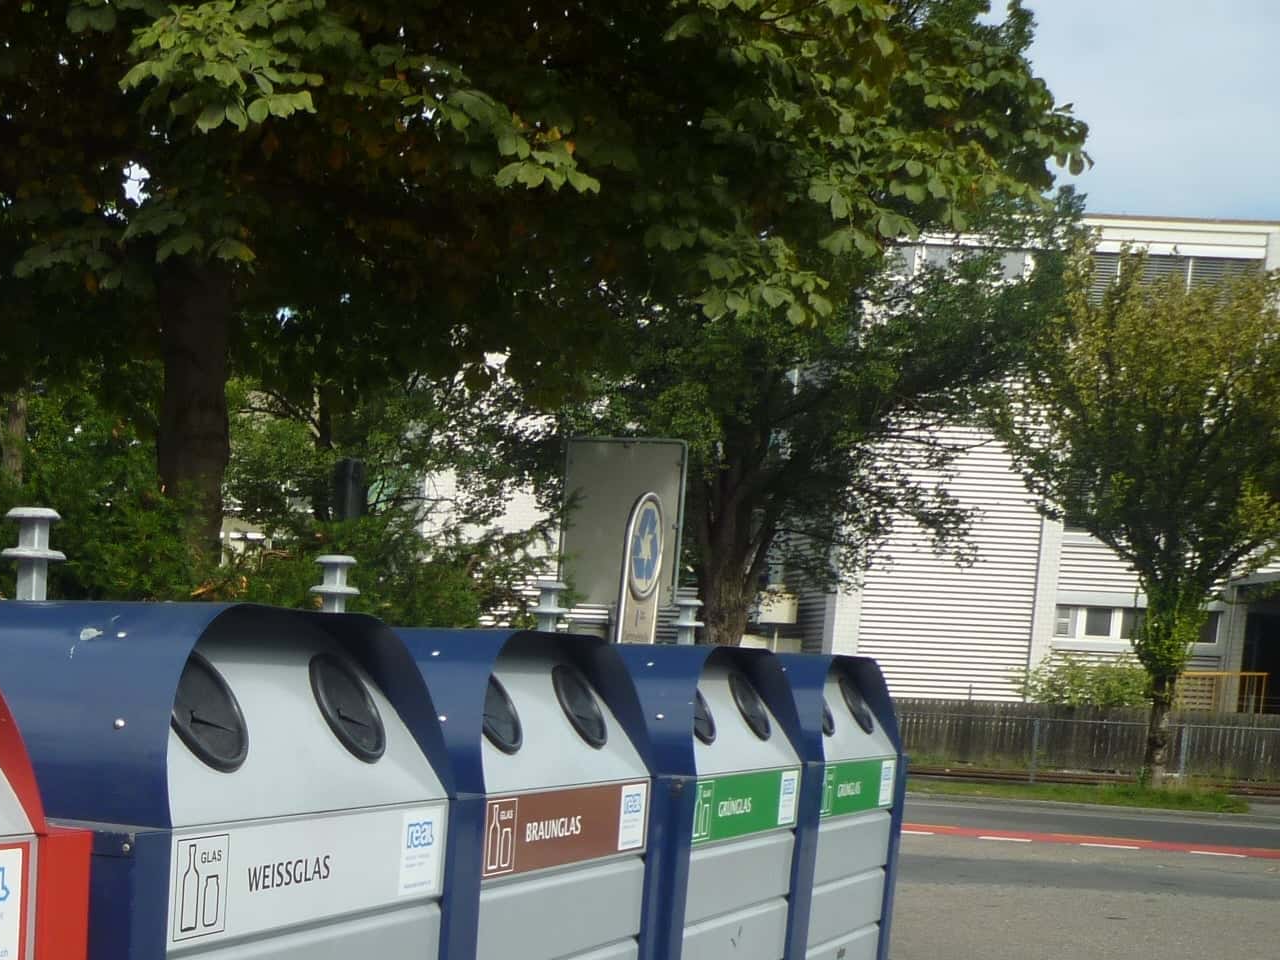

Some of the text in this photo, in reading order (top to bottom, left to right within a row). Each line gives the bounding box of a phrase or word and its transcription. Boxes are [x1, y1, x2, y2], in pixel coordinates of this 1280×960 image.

[525, 815, 582, 842] BRAUNGLAS
[201, 850, 222, 864] GLAS
[247, 855, 331, 892] WEISSGLAS
